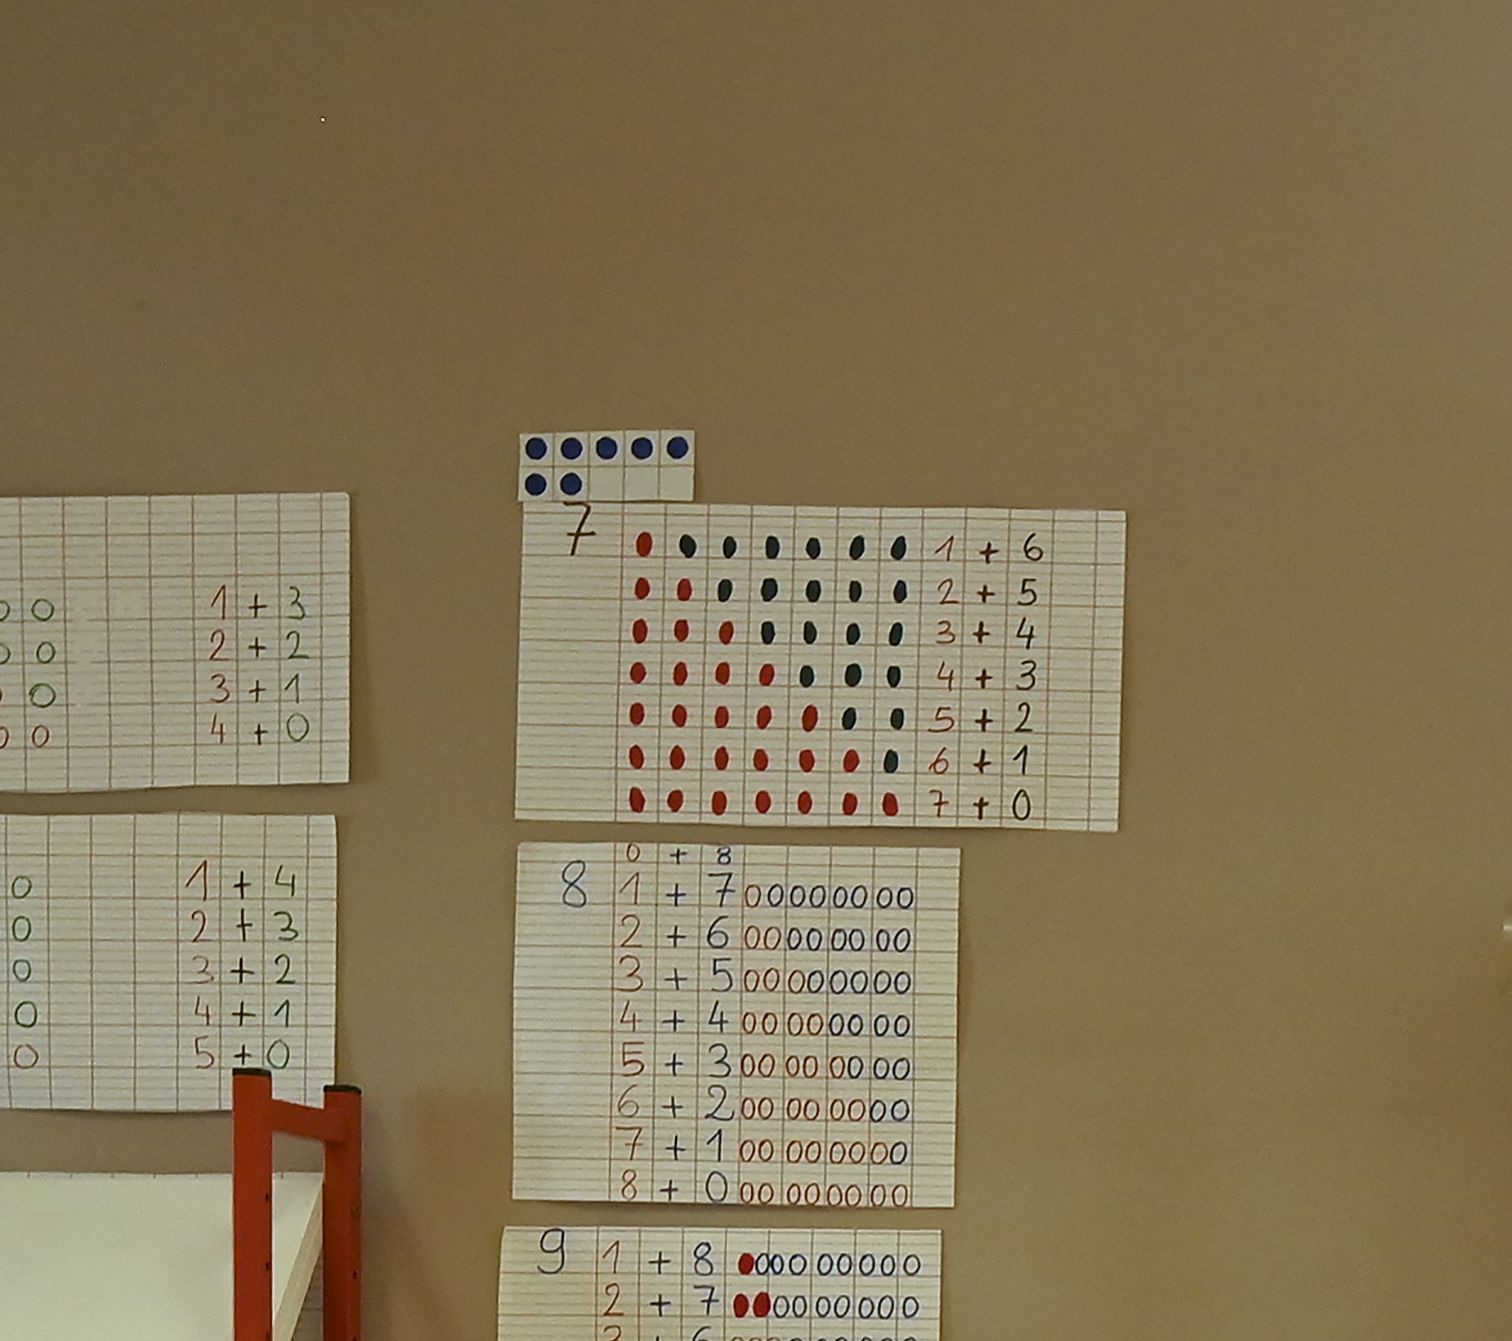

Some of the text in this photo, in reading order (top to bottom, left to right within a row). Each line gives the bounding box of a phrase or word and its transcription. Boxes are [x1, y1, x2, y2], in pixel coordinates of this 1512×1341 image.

[564, 502, 596, 556] 7
[561, 860, 587, 907] 8
[537, 1228, 565, 1274] 9
